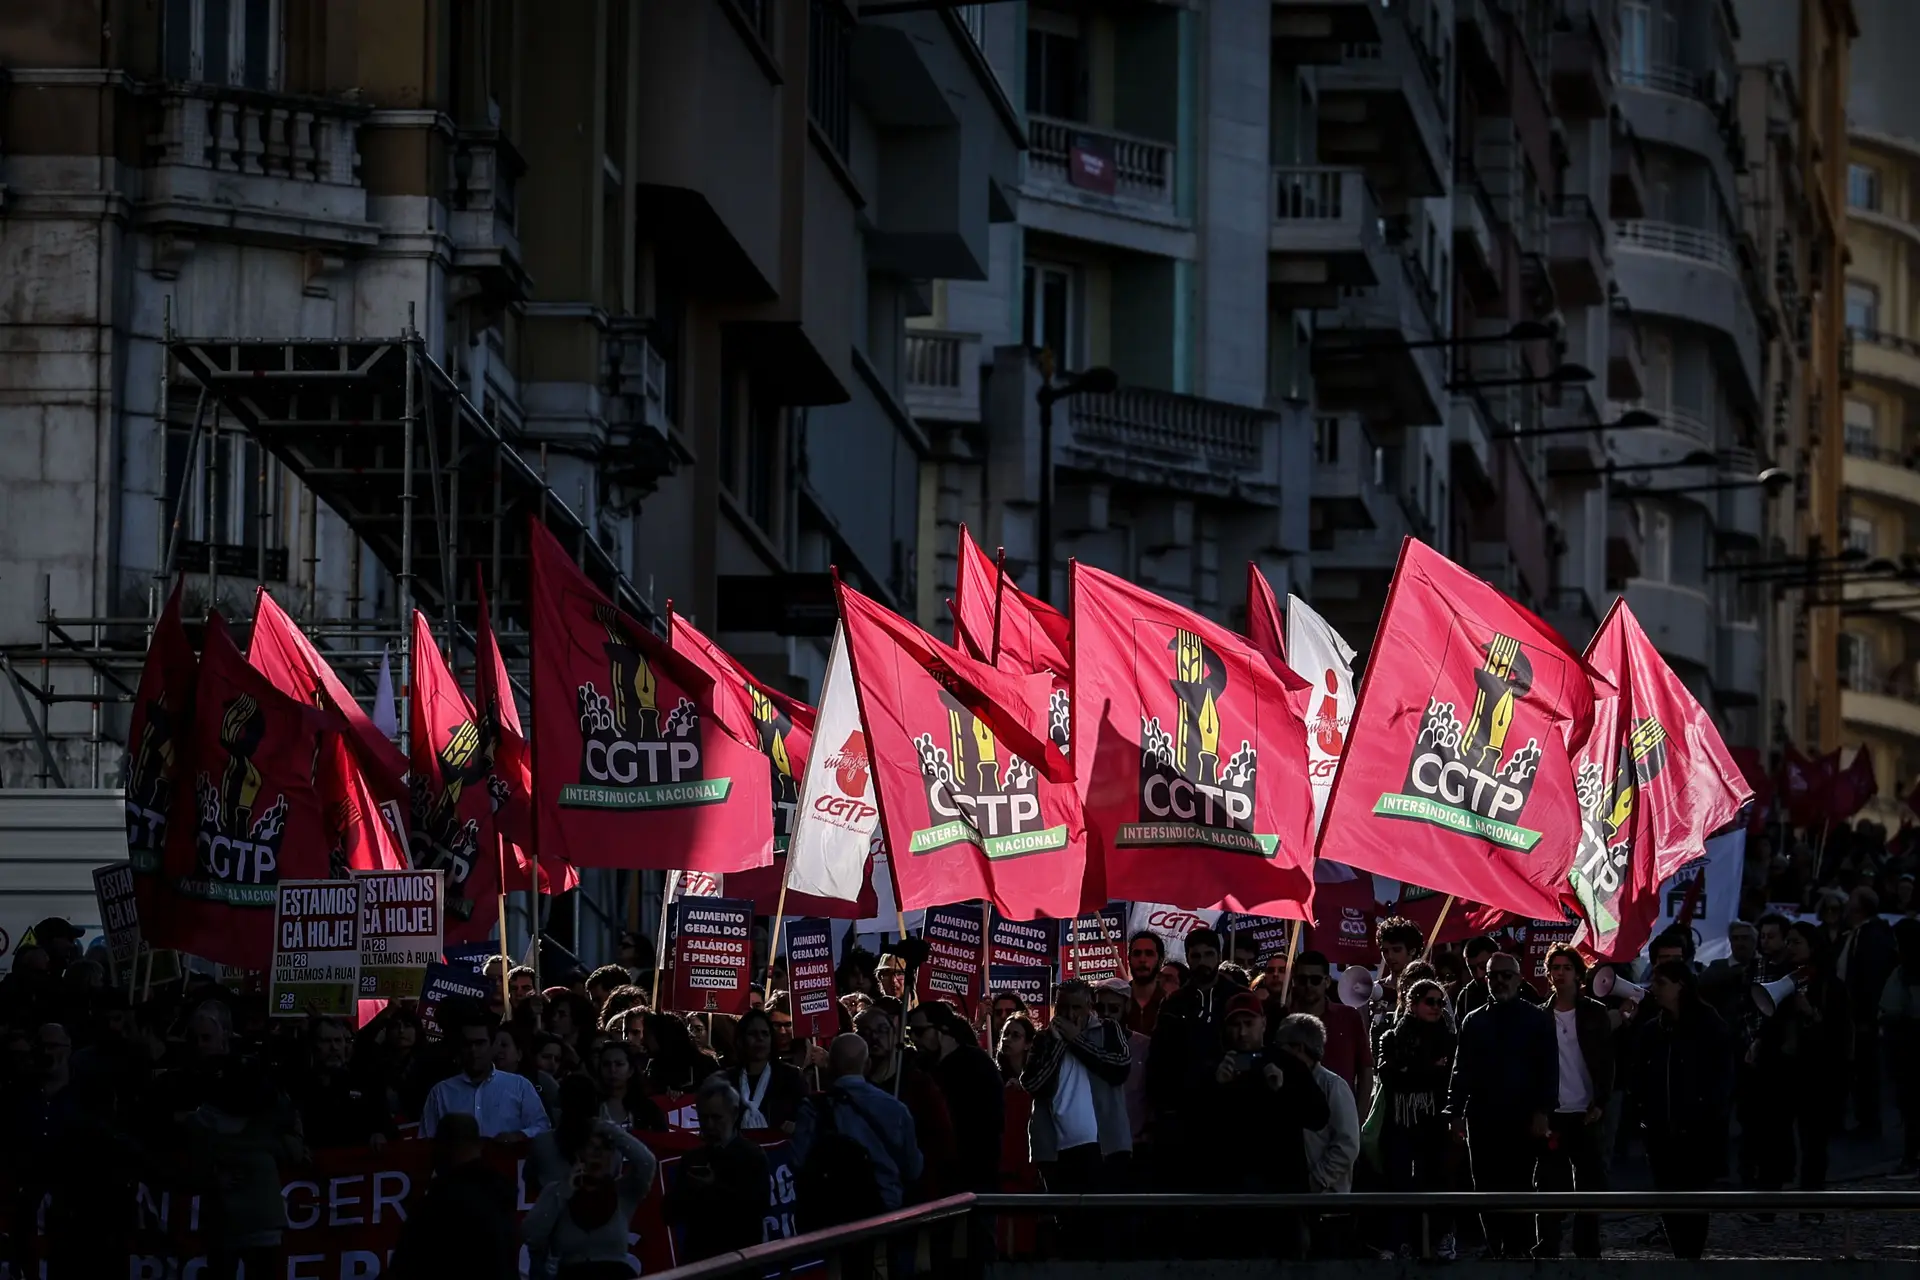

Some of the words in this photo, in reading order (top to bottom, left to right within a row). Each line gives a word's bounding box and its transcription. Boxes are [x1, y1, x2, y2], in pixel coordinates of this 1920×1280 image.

[586, 739, 700, 784] CGTP
[565, 788, 652, 804] INTERSINDICAL
[656, 784, 720, 802] NACIONAL
[1411, 753, 1524, 818] CGTP
[814, 795, 877, 823] CGTP
[1144, 774, 1252, 829] CGTP
[1383, 797, 1473, 828] INTERSINDICAL
[1475, 819, 1526, 846] NACIONAL
[996, 834, 1060, 853] NACIONAL
[1123, 826, 1209, 842] INTERSINDICAL
[1211, 832, 1269, 851] NACIONAL
[282, 888, 357, 916] ESTAMOS
[385, 907, 433, 934] HOJE!
[687, 910, 745, 923] AUMENTO
[933, 913, 979, 931] AUMENTO
[1149, 911, 1209, 933] CGTP
[283, 916, 304, 949] CÁ
[307, 919, 354, 948] HOJE!
[684, 923, 721, 935] GERAL
[723, 926, 747, 937] DOS
[929, 926, 960, 941] GERAL
[960, 932, 980, 945] DOS
[997, 922, 1046, 940] AUMENTO
[373, 939, 386, 951] 28
[687, 938, 743, 953] SALÁRIOS
[793, 933, 826, 947] AUMENTO
[993, 933, 1025, 949] GERAL
[1026, 941, 1048, 953] DOS
[362, 952, 403, 965] OLTAMOS
[406, 950, 414, 964] À
[416, 951, 437, 965] RUA!
[682, 953, 690, 962] E
[691, 953, 745, 967] PENSÕES!
[792, 949, 814, 960] GERAL
[814, 947, 829, 957] DOS
[930, 942, 975, 960] SALÁRIOS
[994, 949, 1043, 967] SALÁRIOS
[276, 955, 292, 967] DIA
[293, 954, 307, 967] 28
[795, 962, 828, 977] SALÁRIOS
[276, 968, 323, 982] VOLTAMOS
[326, 965, 333, 980] À
[335, 967, 356, 980] RUA!
[691, 967, 736, 977] EMERGÊNCIA
[361, 976, 376, 987] 28
[433, 978, 484, 999] AUMENTO
[691, 977, 736, 987] NACIONAL
[794, 980, 799, 990] E
[800, 975, 832, 990] PENSÕES!
[280, 993, 295, 1004] 28
[802, 1000, 828, 1012] NACIONAL
